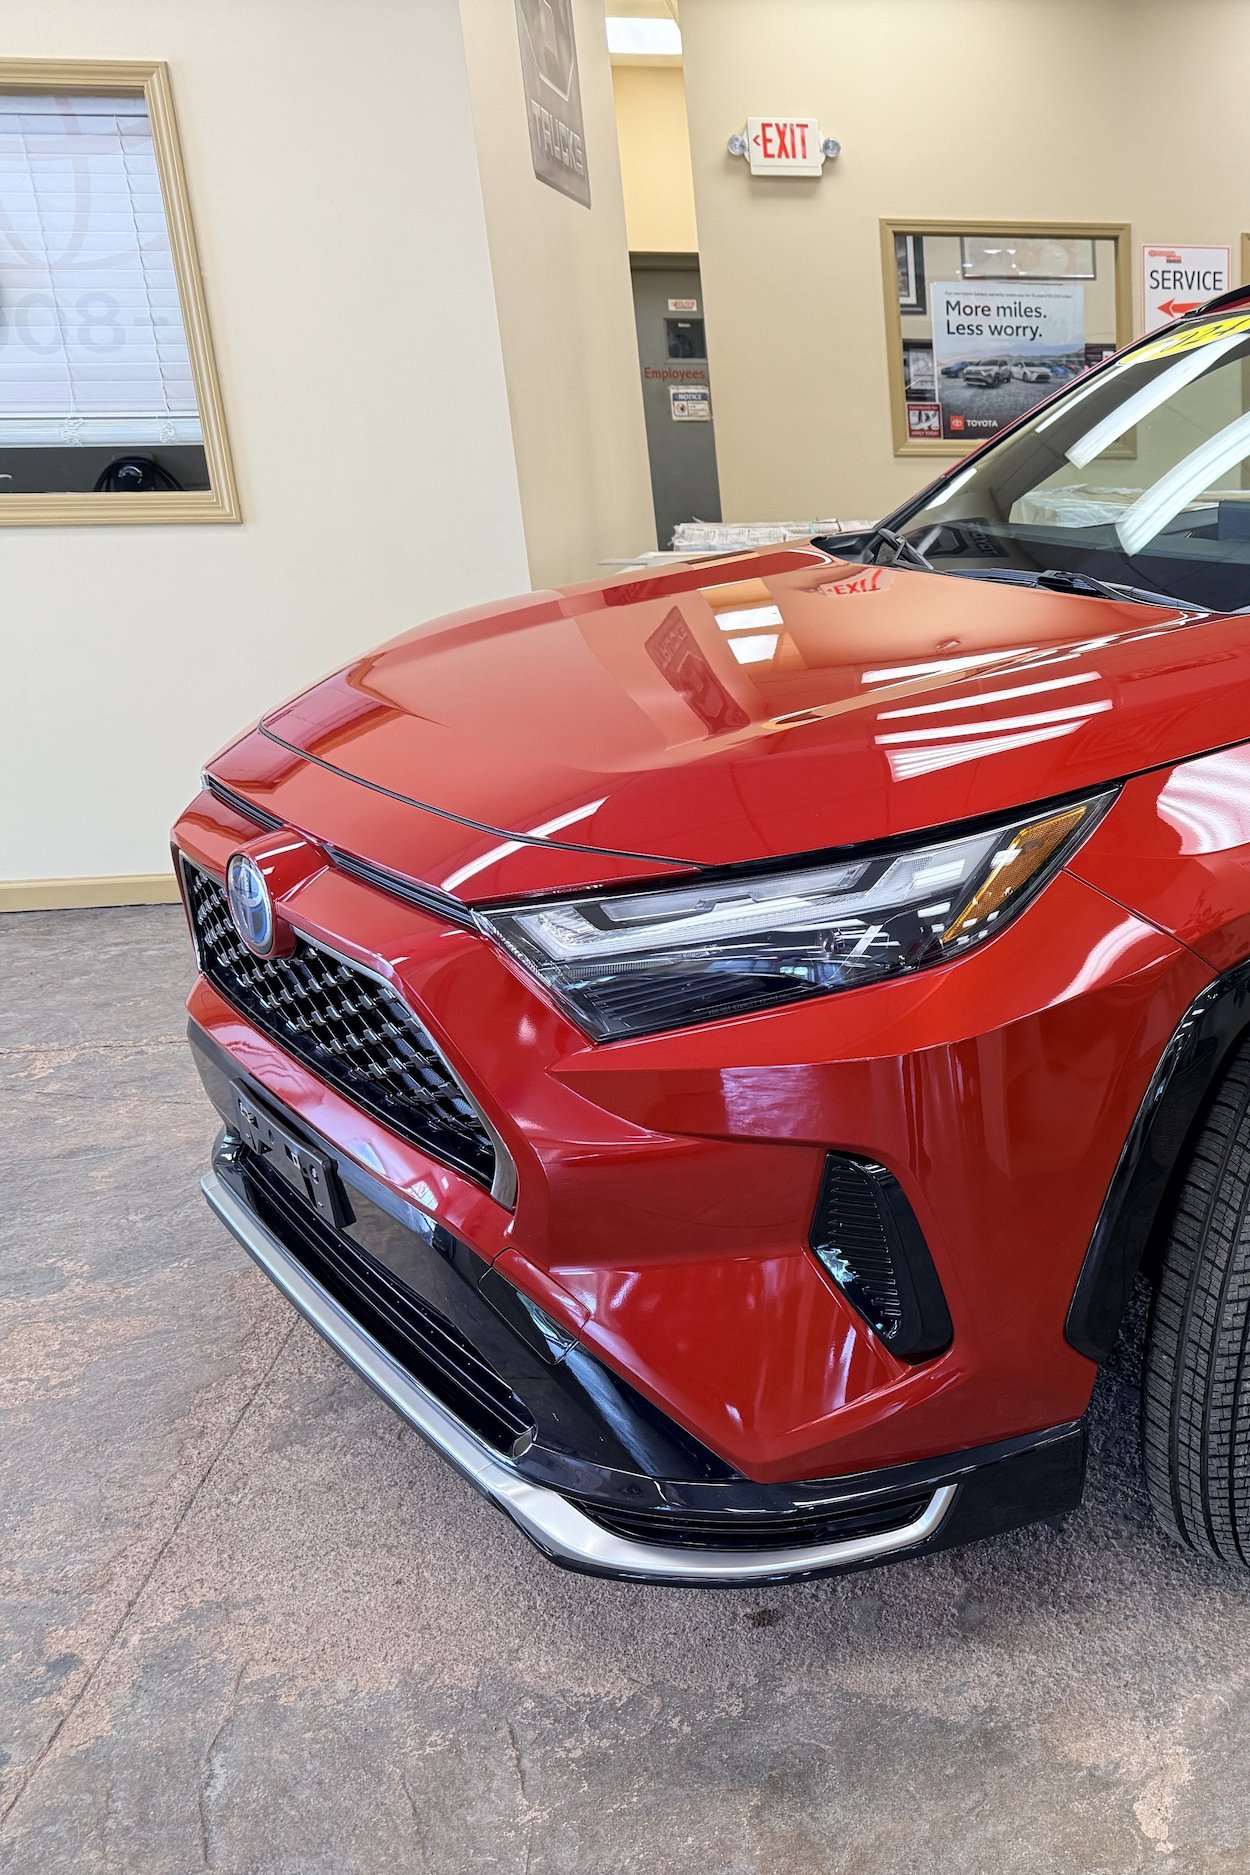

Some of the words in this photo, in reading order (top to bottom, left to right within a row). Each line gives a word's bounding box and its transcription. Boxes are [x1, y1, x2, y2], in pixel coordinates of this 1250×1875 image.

[531, 98, 585, 177] TRUCKS
[761, 123, 809, 159] EXIT
[1149, 269, 1223, 291] SERVICE
[946, 300, 991, 317] More
[997, 301, 1047, 318] miles.
[946, 320, 984, 336] Less
[988, 323, 1043, 341] worry.
[644, 367, 705, 382] Employees
[678, 393, 702, 401] NOTICE
[966, 420, 999, 428] TOYOTA
